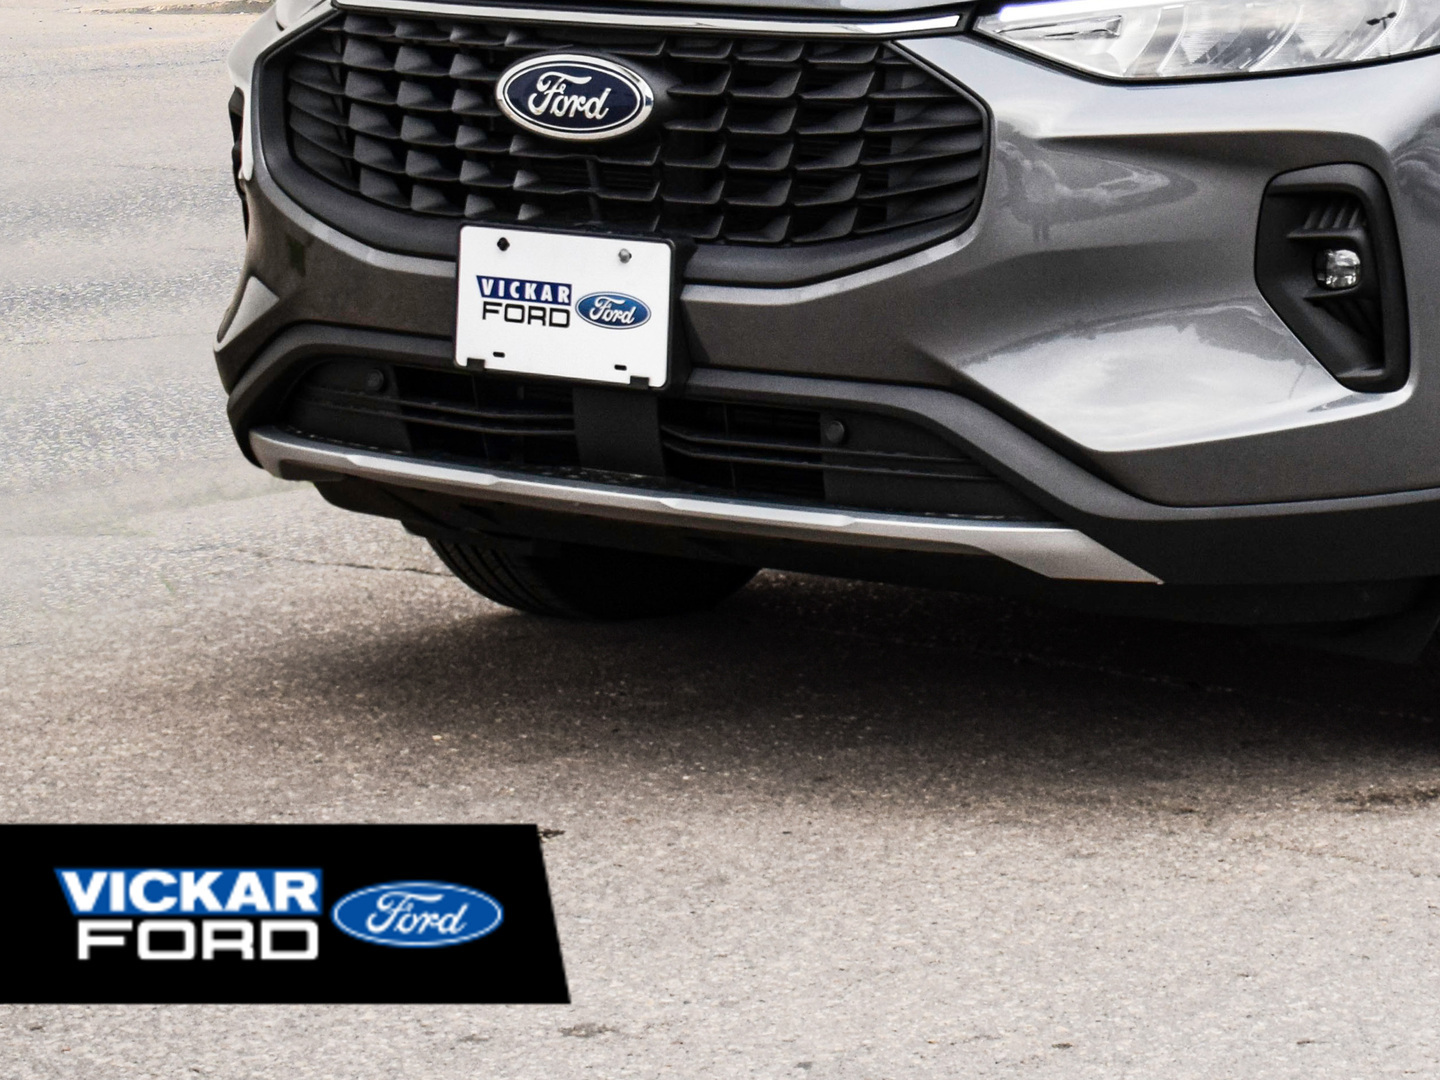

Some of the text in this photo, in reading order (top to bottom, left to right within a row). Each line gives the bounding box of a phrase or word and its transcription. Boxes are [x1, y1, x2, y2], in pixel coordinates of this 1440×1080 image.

[527, 71, 612, 120] Ford
[481, 277, 570, 304] VICKAR
[482, 301, 571, 329] FORD
[589, 296, 636, 325] Ford
